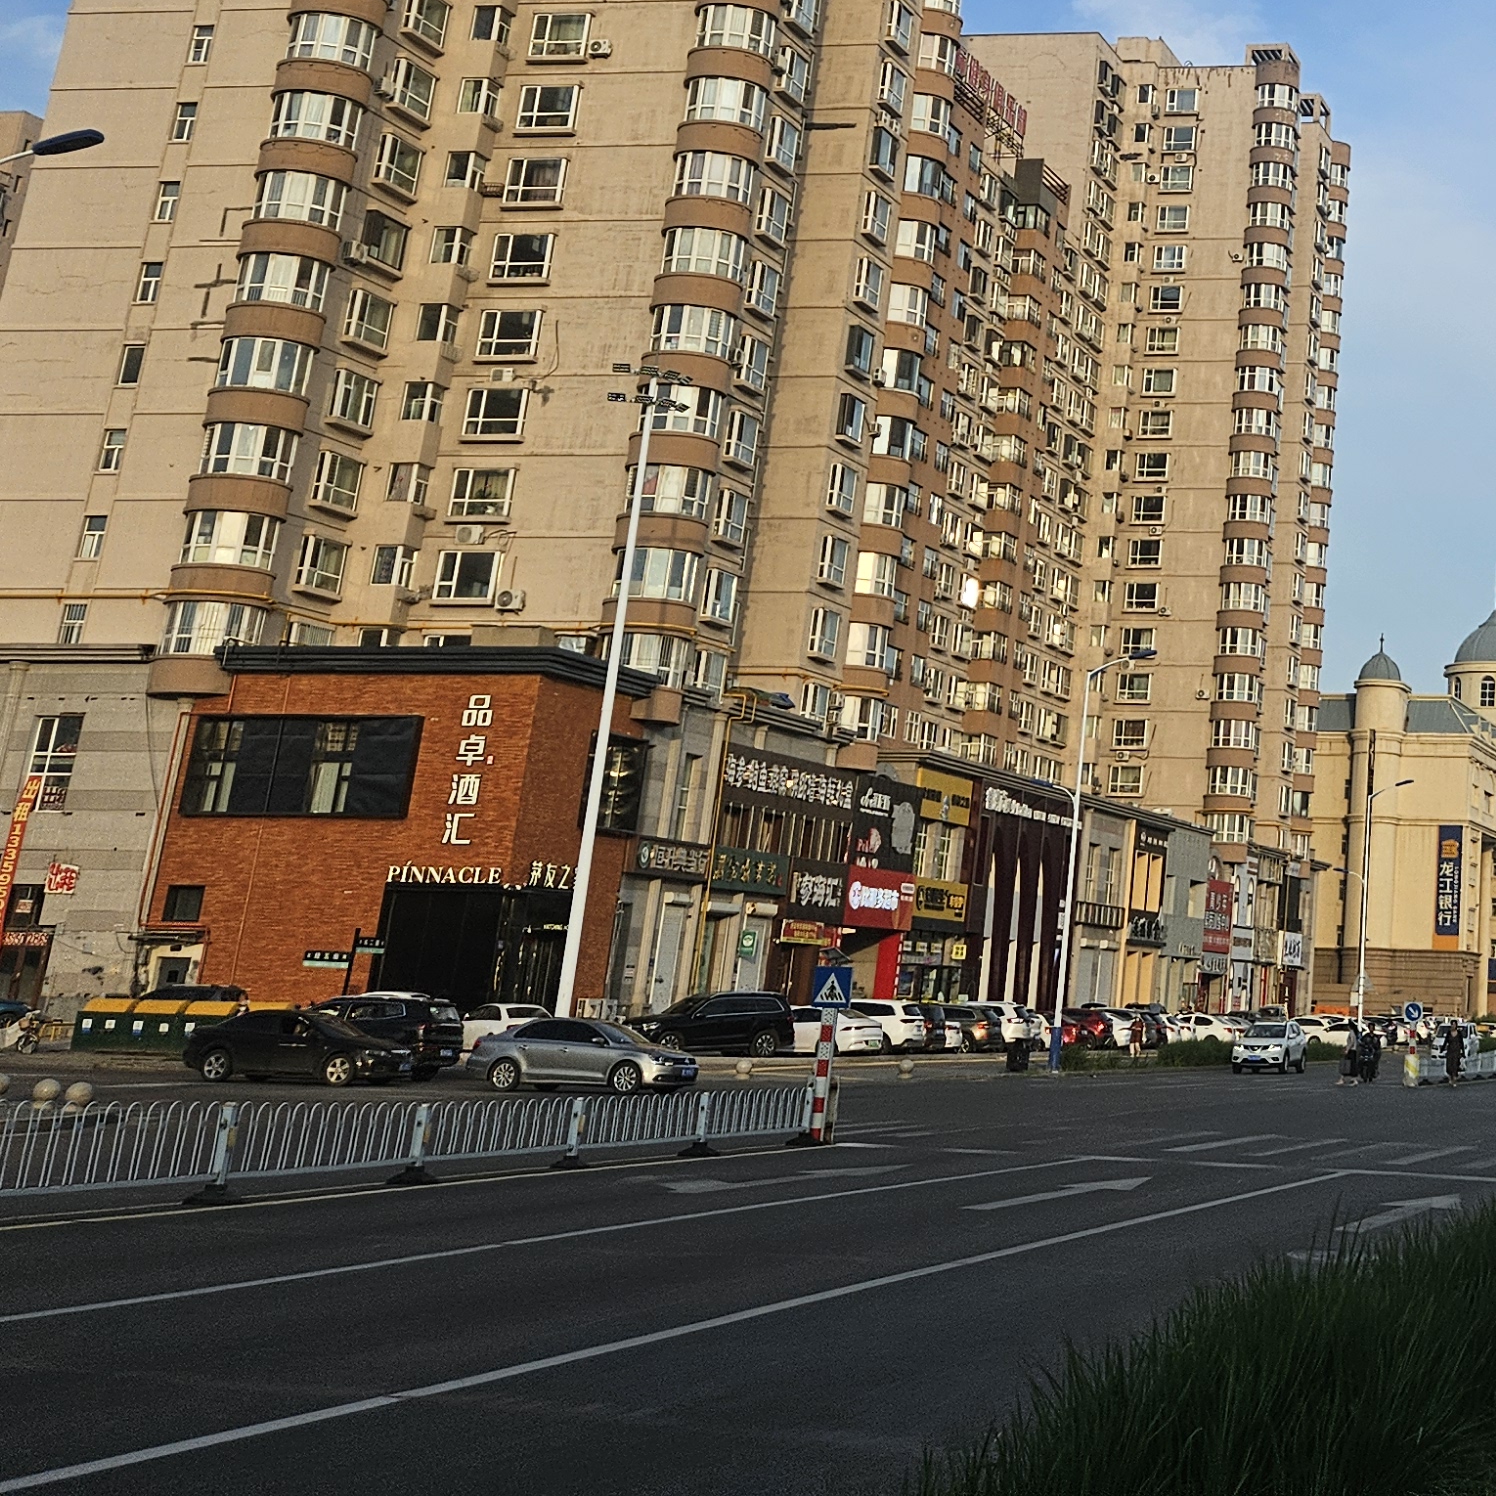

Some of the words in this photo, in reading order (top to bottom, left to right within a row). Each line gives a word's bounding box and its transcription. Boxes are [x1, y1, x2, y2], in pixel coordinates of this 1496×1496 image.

[442, 694, 493, 845] 品卓酒汇
[1438, 861, 1454, 926] 龙江银行
